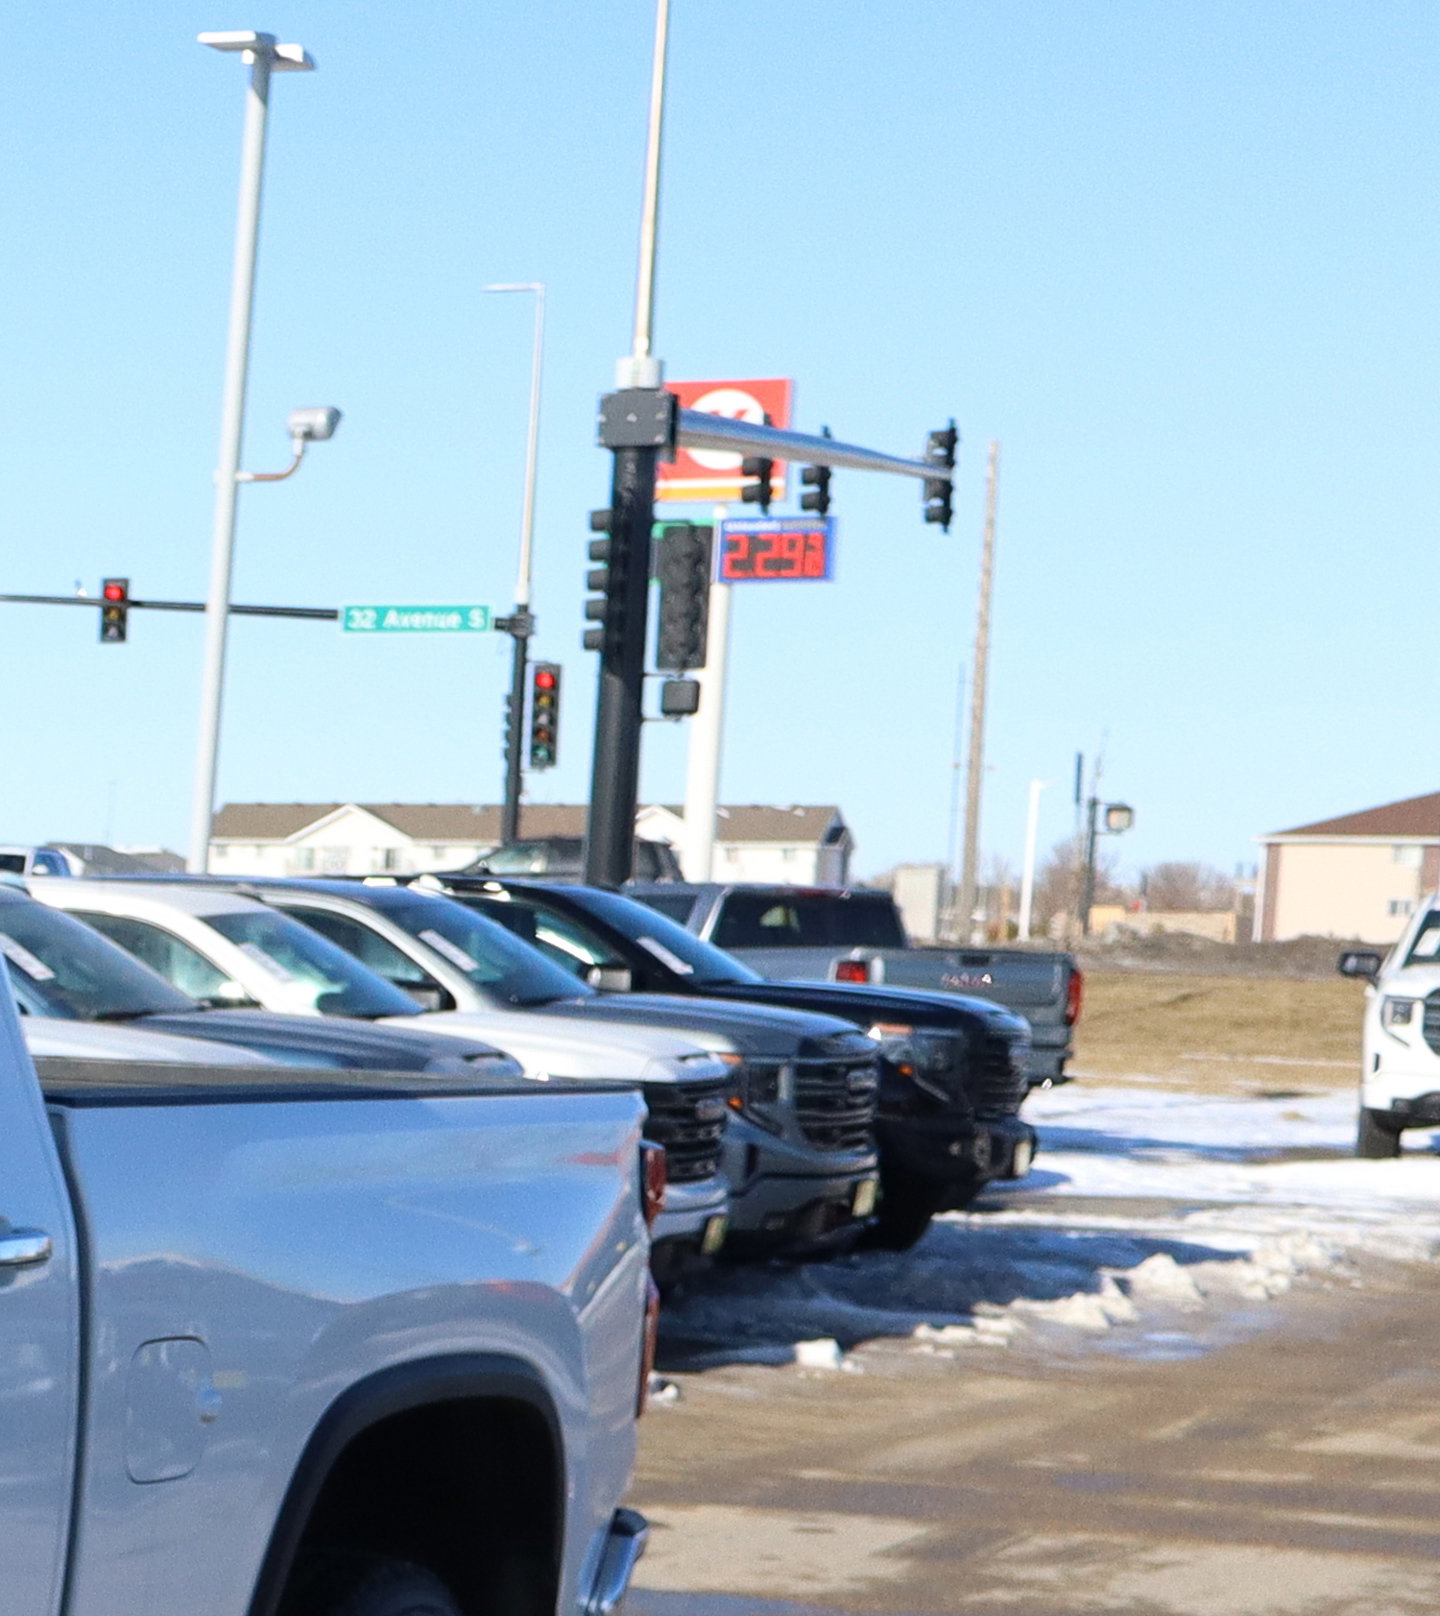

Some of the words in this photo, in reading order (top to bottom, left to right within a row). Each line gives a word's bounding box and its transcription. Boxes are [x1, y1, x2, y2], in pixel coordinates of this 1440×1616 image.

[348, 608, 377, 629] 32
[383, 608, 462, 629] Avenue
[467, 607, 485, 629] S
